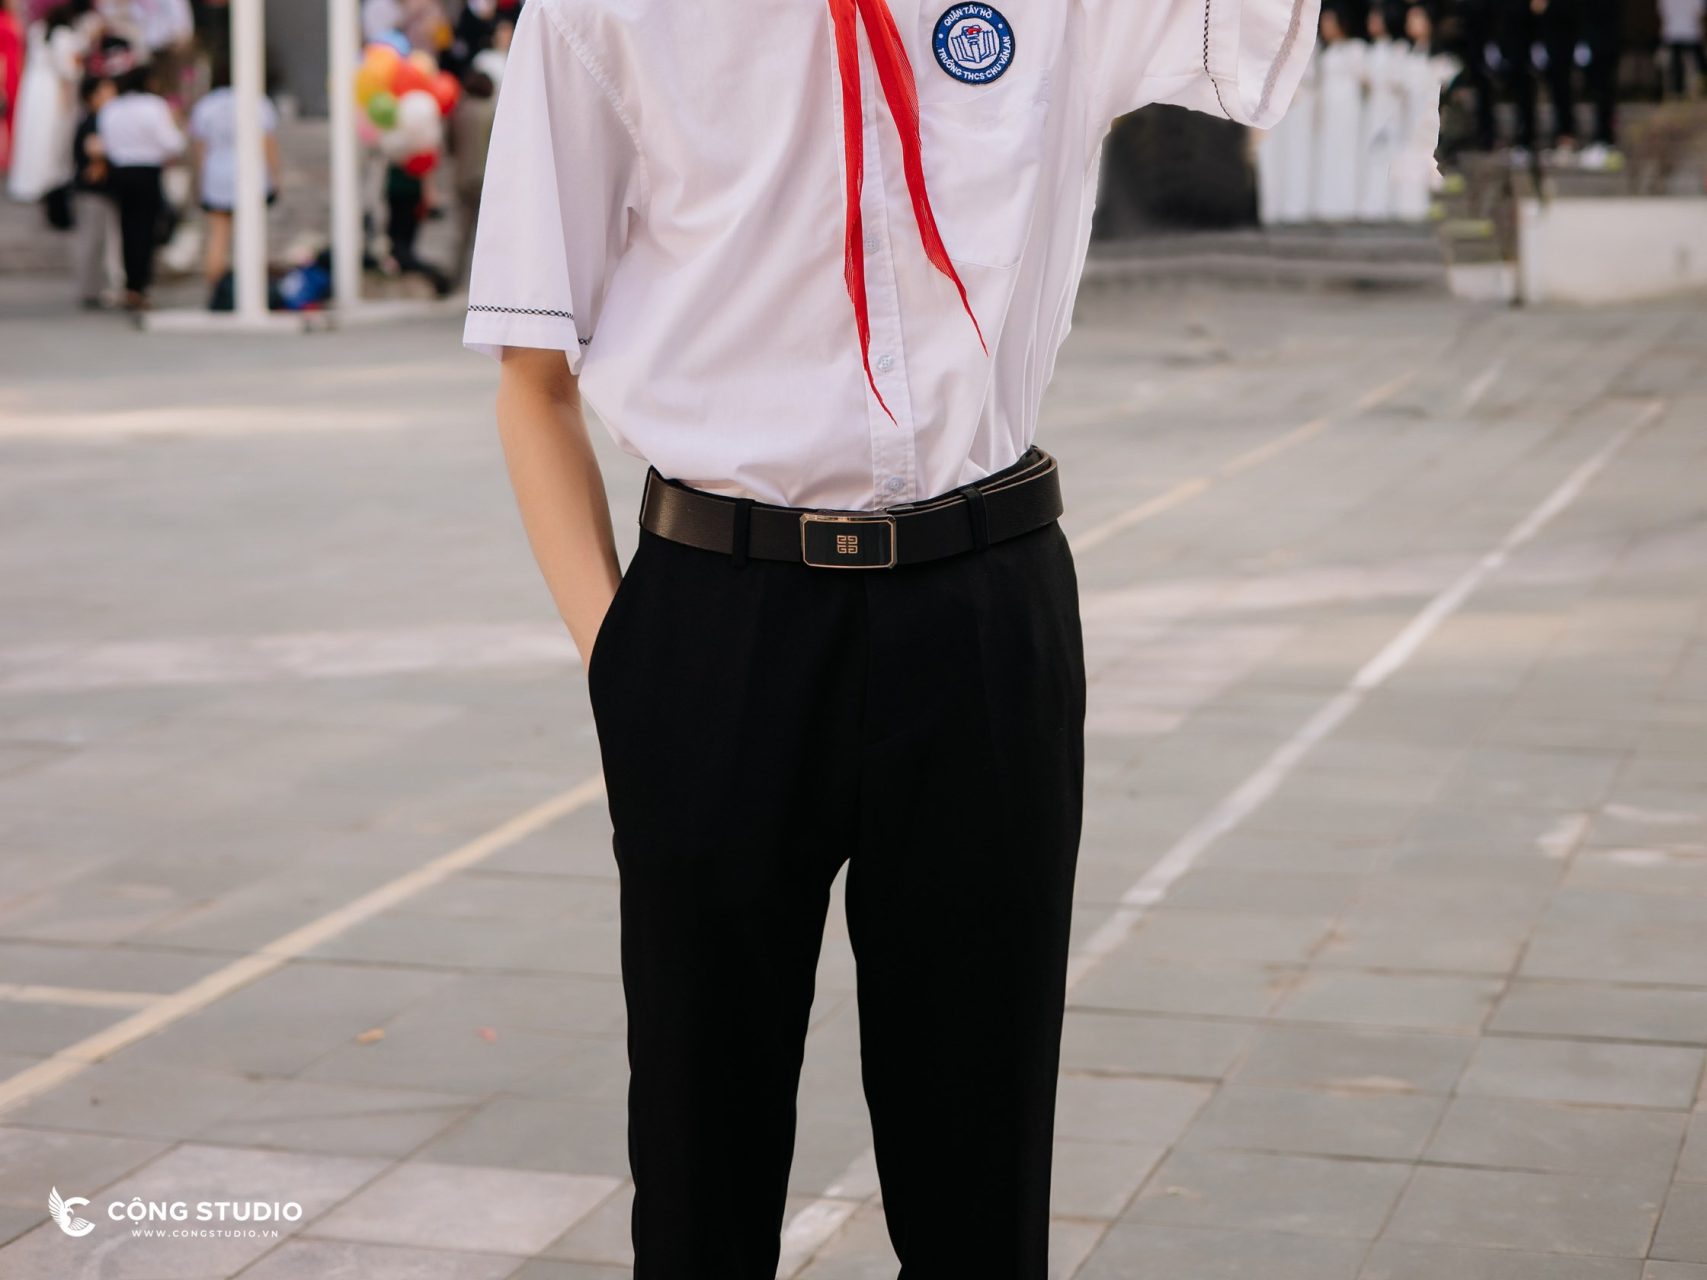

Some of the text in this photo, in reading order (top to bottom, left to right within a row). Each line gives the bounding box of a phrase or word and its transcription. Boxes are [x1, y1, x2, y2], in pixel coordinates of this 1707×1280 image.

[944, 4, 992, 26] QUẬN TÂY HỒ
[963, 70, 985, 80] THCS
[985, 64, 1002, 78] CHU
